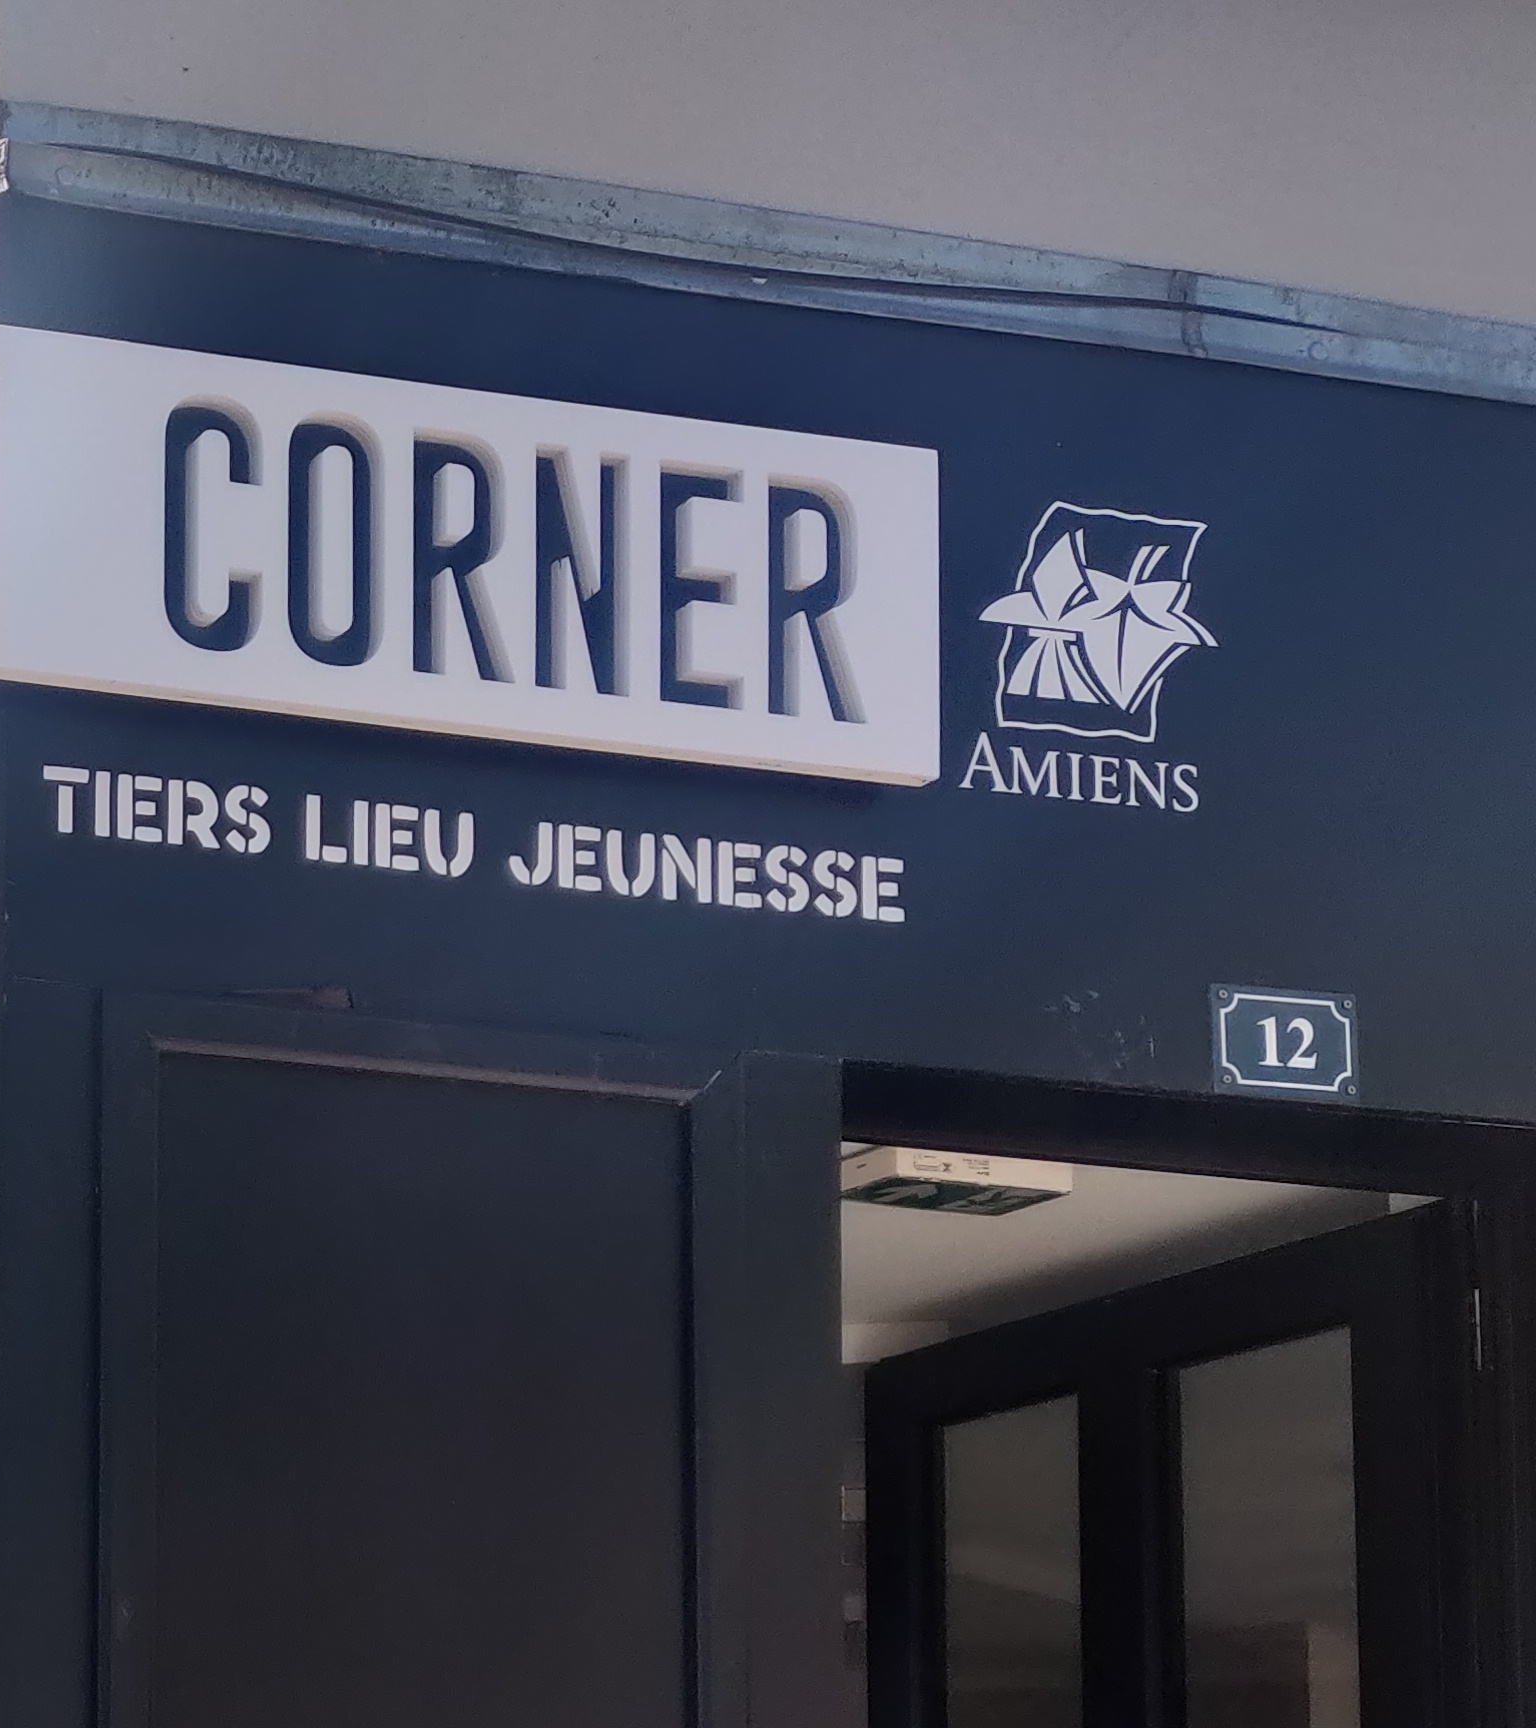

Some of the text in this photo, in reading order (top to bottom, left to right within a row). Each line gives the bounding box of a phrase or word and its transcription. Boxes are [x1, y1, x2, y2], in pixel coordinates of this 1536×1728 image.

[161, 396, 868, 725] CORNER
[958, 731, 1202, 813] AMIENS
[42, 764, 907, 924] TIERS LIEU JEUNESSE
[1256, 1014, 1320, 1072] 12
